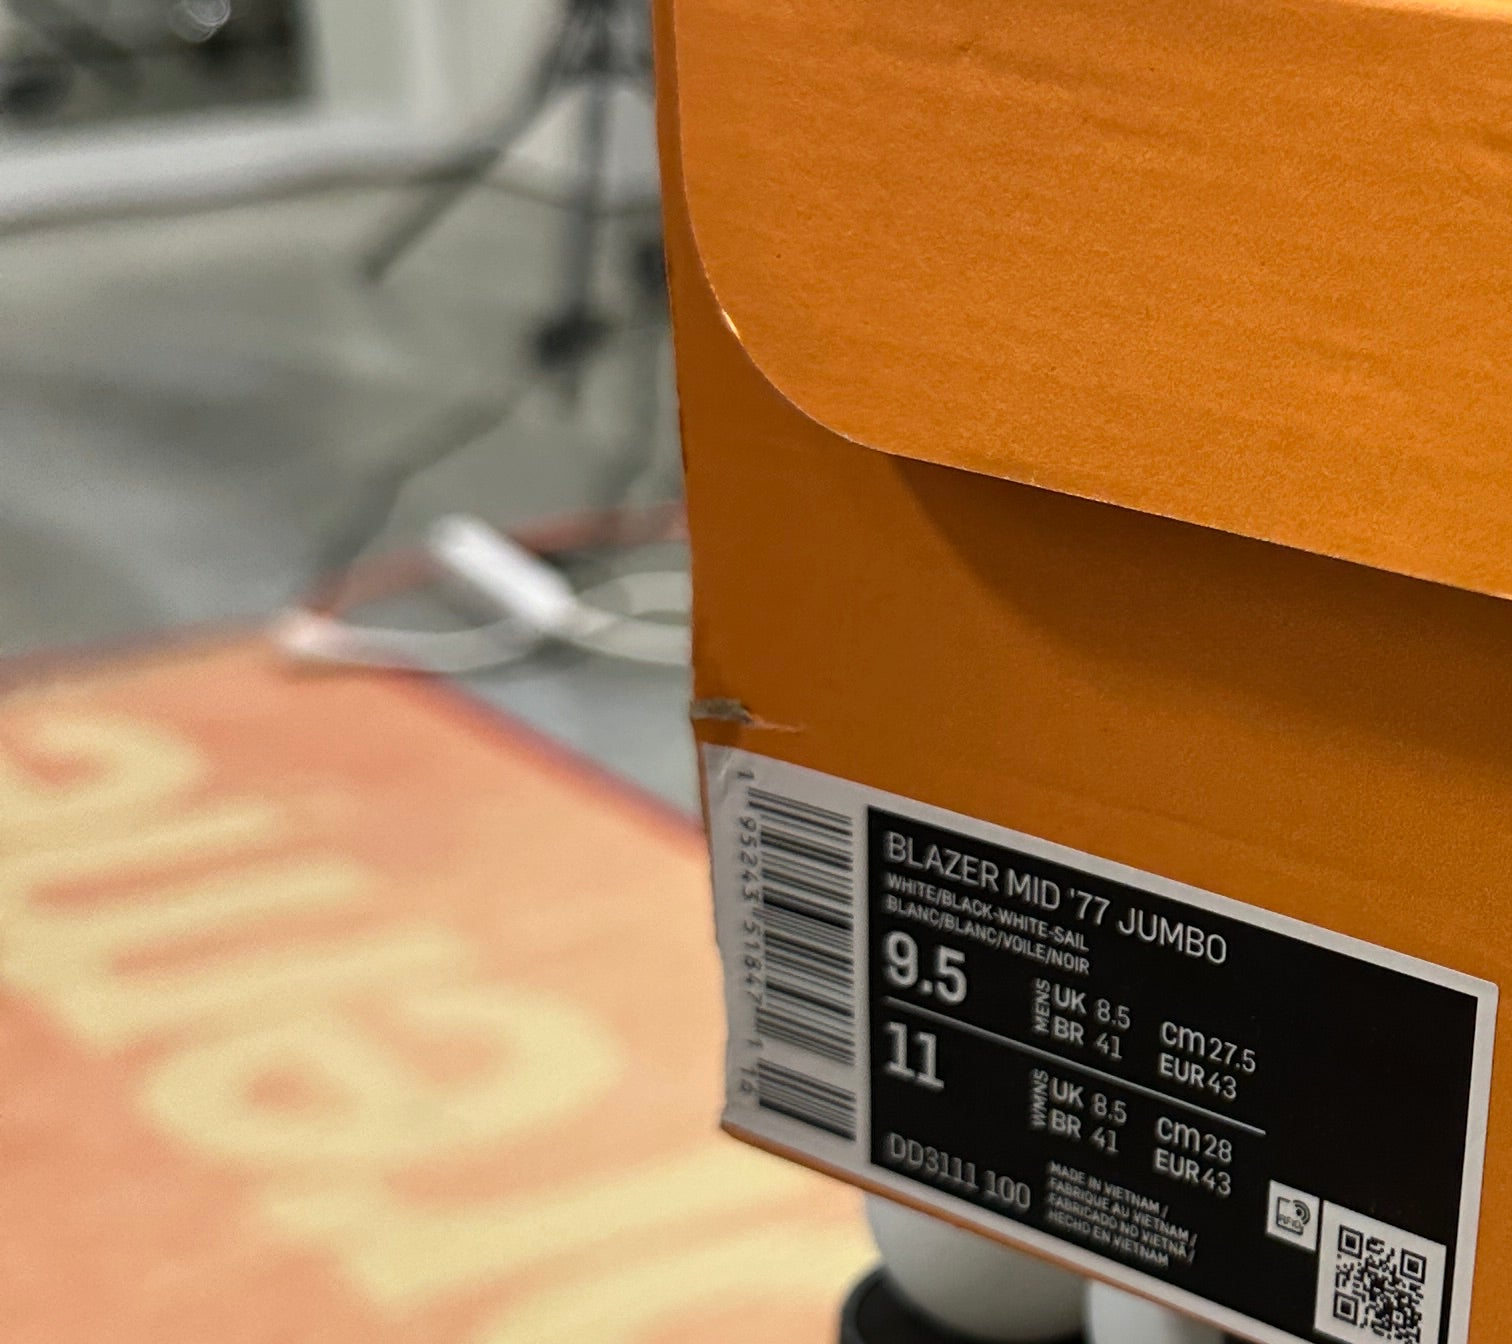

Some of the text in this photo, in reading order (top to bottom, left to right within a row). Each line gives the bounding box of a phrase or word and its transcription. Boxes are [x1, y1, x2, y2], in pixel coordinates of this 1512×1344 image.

[886, 831, 1228, 964] BLAZER MID '77 JUMBO
[886, 872, 1090, 953] WHITE/BLACK-WHITE-SAIL
[885, 893, 1090, 976] BLANC/BLANC/VOILE/NOIR
[885, 929, 968, 1004] 9.5
[1033, 977, 1051, 1033] MENS
[1054, 983, 1131, 1030] UK 8.5
[884, 1021, 945, 1091] 11
[1053, 1015, 1122, 1060] BR 41
[1030, 1067, 1049, 1130] WMNS
[1051, 1076, 1128, 1125] UK 8.5
[1050, 1109, 1119, 1154] BR 41
[889, 1132, 1032, 1213] DD3111 100
[1049, 1160, 1086, 1185] MADE
[1088, 1175, 1102, 1192] IN
[1103, 1181, 1160, 1215] VIETNAM
[1048, 1192, 1118, 1231] FABRICADO
[1119, 1220, 1140, 1239] NO
[1048, 1209, 1170, 1269] HECHO EN VIETNAM
[1110, 1201, 1131, 1219] AU
[1132, 1209, 1190, 1243] VIETNAM
